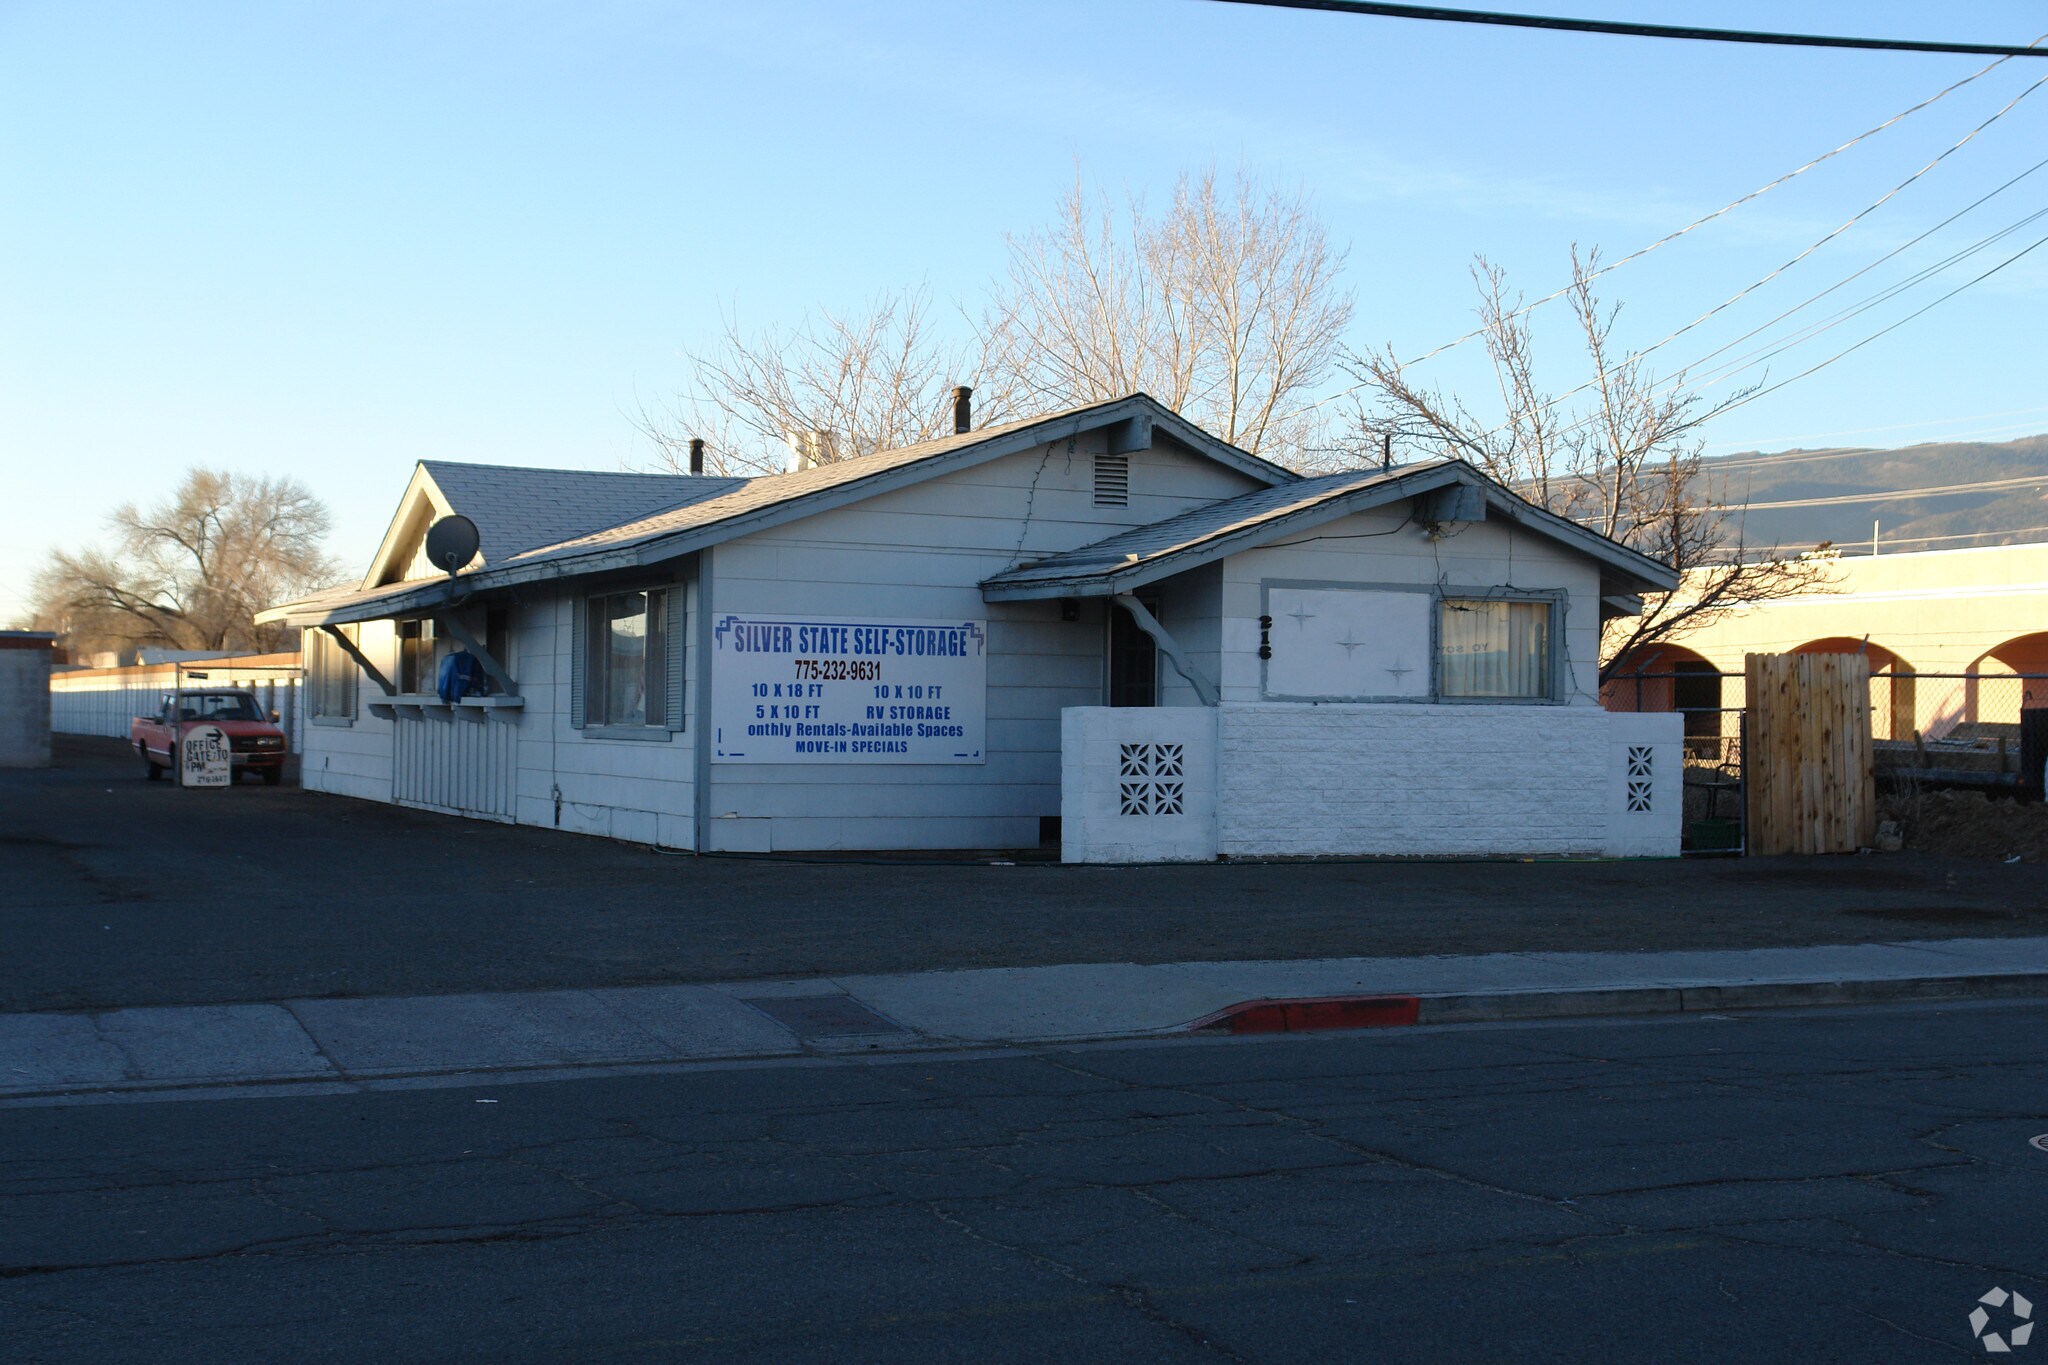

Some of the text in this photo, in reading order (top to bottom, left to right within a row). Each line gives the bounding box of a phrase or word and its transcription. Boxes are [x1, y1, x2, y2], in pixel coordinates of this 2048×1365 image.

[735, 624, 967, 656] SILVER STATE SELF-STORAGE
[1259, 615, 1273, 660] 216
[794, 660, 881, 680] 775-232-9631
[752, 683, 823, 698] 10 X 18 FT
[874, 685, 942, 699] 10 X 10 FT
[756, 705, 820, 719] 5 X 10 FT
[866, 706, 951, 720] RV STORAGE
[748, 722, 964, 738] onthly Rentals-Available Spaces
[186, 738, 222, 751] OFFICE
[795, 740, 908, 753] MOVE-IN SPECIALS
[186, 750, 211, 762] GATE
